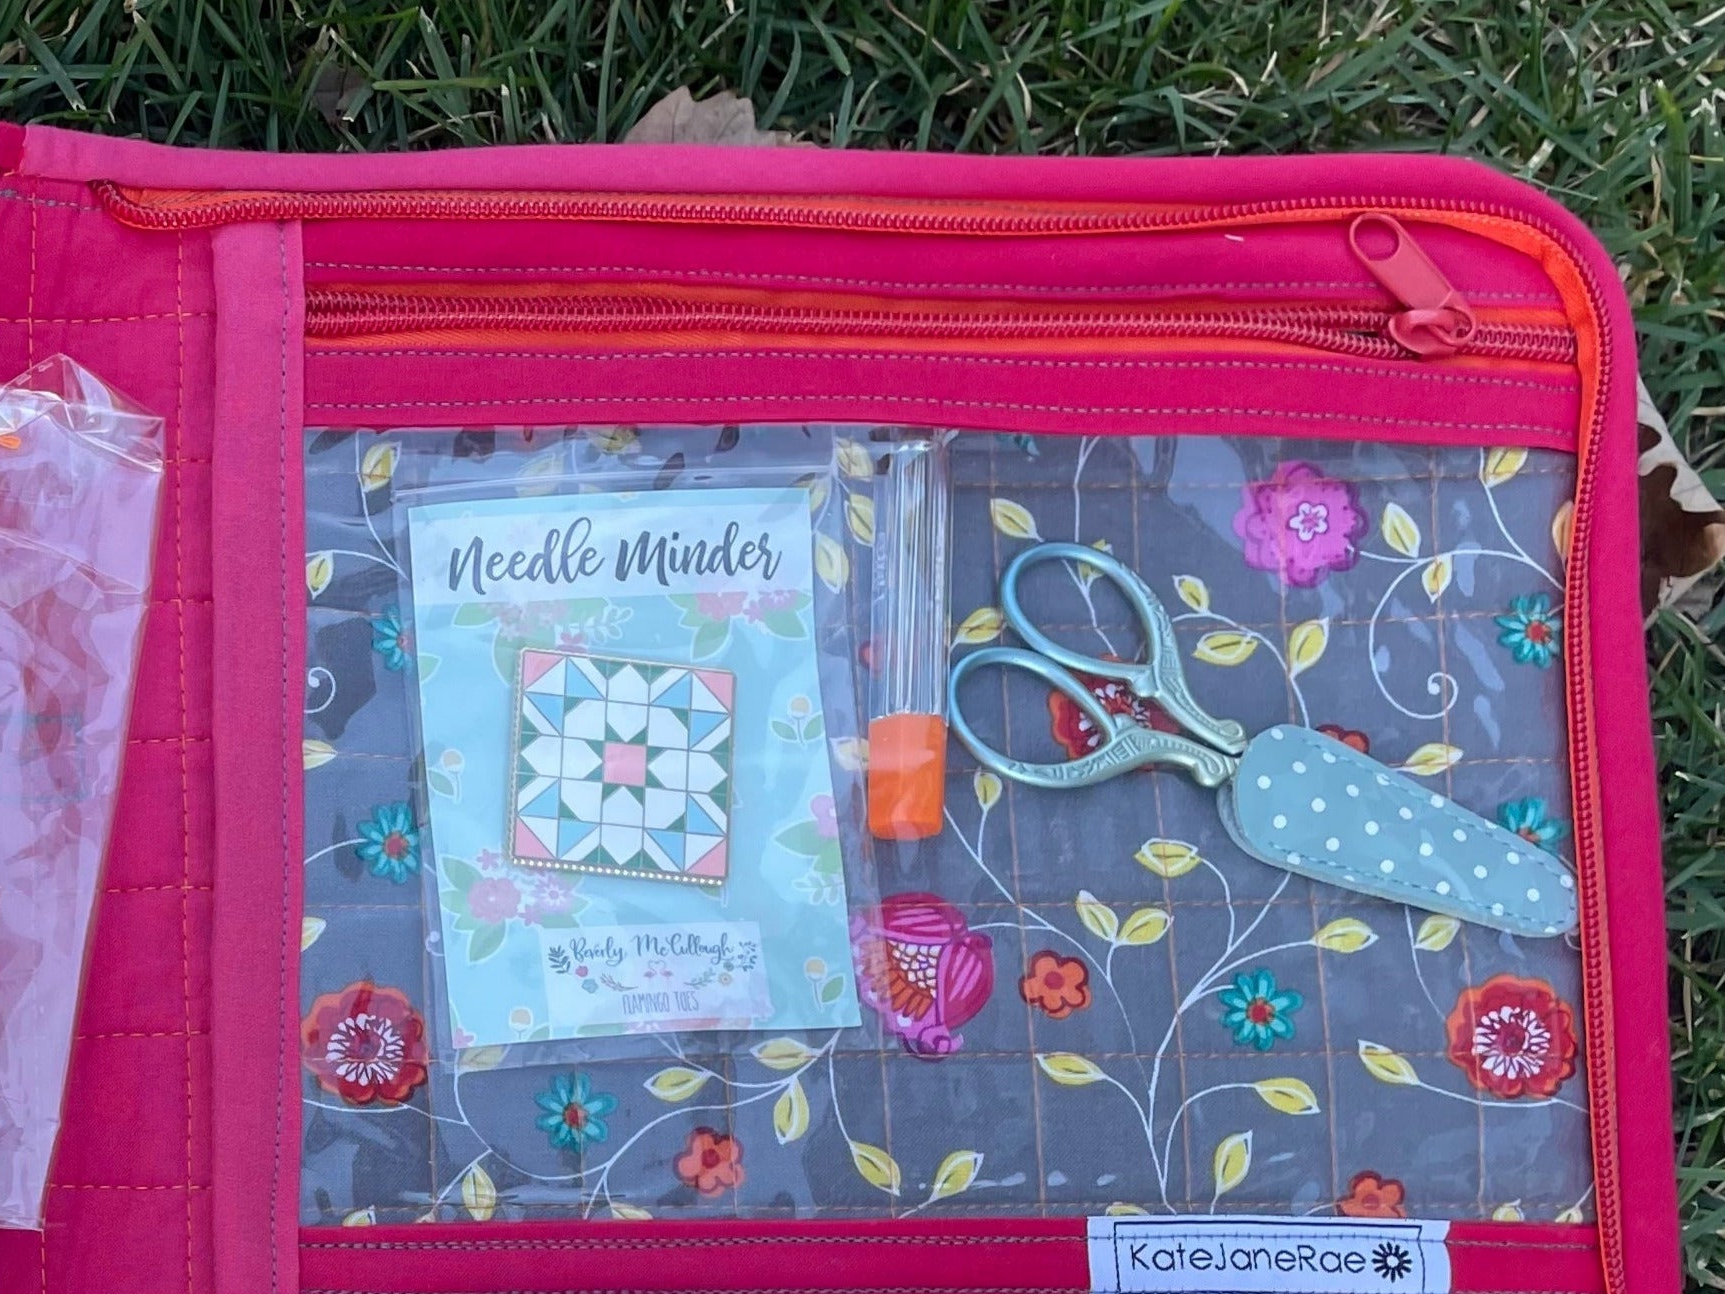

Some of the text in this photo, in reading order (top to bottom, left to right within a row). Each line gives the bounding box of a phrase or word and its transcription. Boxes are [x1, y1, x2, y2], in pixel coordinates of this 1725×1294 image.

[449, 516, 782, 595] Needle Minder
[569, 937, 625, 966] Beverly
[623, 990, 699, 1015] FLAMINGO TOES
[1130, 1242, 1366, 1274] KateJaneRae
